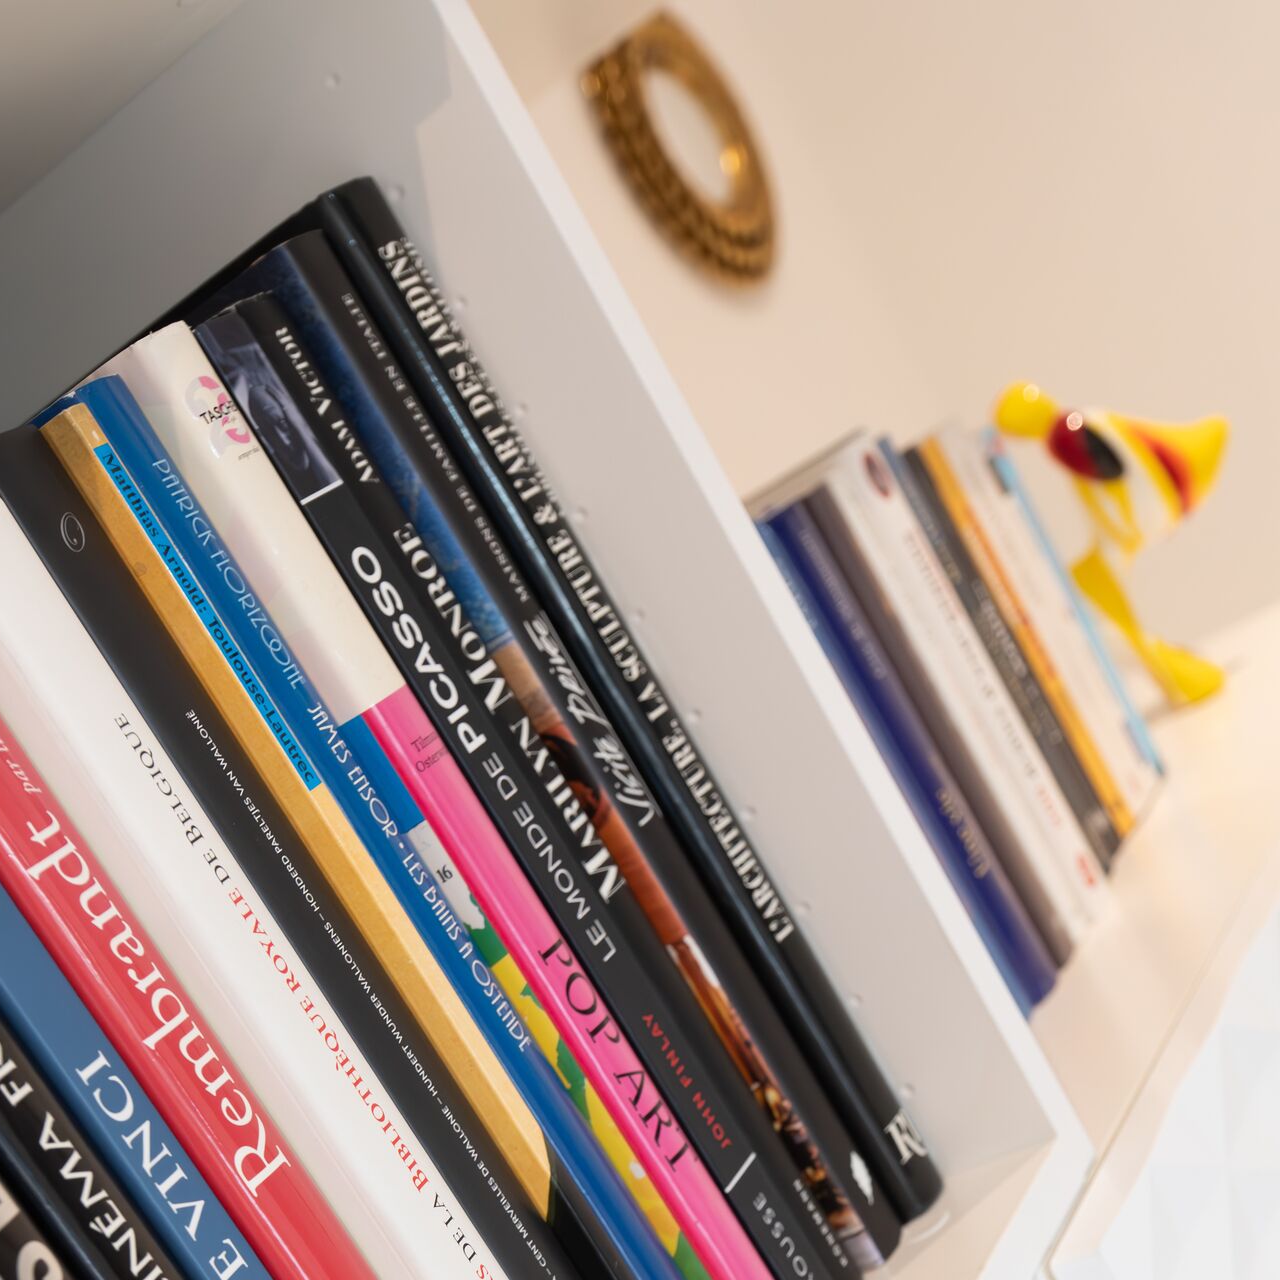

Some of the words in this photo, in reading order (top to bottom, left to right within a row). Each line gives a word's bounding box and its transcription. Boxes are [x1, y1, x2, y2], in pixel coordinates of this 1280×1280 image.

[377, 238, 465, 359] JARDINS
[273, 325, 334, 417] VICTOR
[449, 358, 495, 418] DES
[329, 418, 381, 486] ADAM
[482, 415, 544, 501] L'ART
[532, 497, 562, 526] &
[99, 450, 163, 540] Matthias
[157, 542, 209, 614] Arnold:
[207, 615, 316, 783] Toulouse-Lautrec
[391, 521, 516, 714] MONROE
[546, 527, 648, 682] SCULPTURE
[348, 543, 489, 754] PICASSO
[636, 681, 670, 721] LA
[150, 457, 217, 547] PATRICK
[305, 701, 353, 764] JAMES
[346, 765, 399, 840] ENSOR
[401, 852, 430, 887] LES
[422, 884, 463, 941] BAINS
[469, 958, 538, 1053] OSTENDE
[185, 709, 229, 771] WALLONIË
[4, 757, 43, 796] par
[113, 711, 206, 846] BELGIQUE
[225, 770, 245, 797] VAN
[480, 751, 520, 801] DE
[581, 725, 663, 832] Visite
[242, 796, 283, 854] PARELTJES
[507, 715, 628, 903] MARILYN
[201, 847, 231, 885] DE
[280, 854, 320, 913] HONDERD
[510, 800, 592, 921] MONDE
[227, 886, 302, 994] ROYALE
[322, 921, 372, 994] WALLONIENS
[584, 918, 618, 962] LE
[0, 808, 294, 1202] Rembrandt
[368, 992, 404, 1044] WUNDER
[401, 1043, 438, 1096] HUNDERT
[537, 933, 621, 1047] POP
[612, 1054, 702, 1173] ART
[640, 1012, 695, 1089] FINLAY
[297, 994, 430, 1193] BIBLIOTHÈQUE
[691, 1091, 733, 1149] JOHN
[74, 1049, 209, 1242] VINCI
[441, 1105, 479, 1160] WALLONIE
[476, 1160, 490, 1177] DE
[431, 1191, 455, 1227] LA
[486, 1176, 529, 1239] MERVEILLES
[451, 1226, 478, 1262] DE
[525, 1239, 547, 1268] CENT
